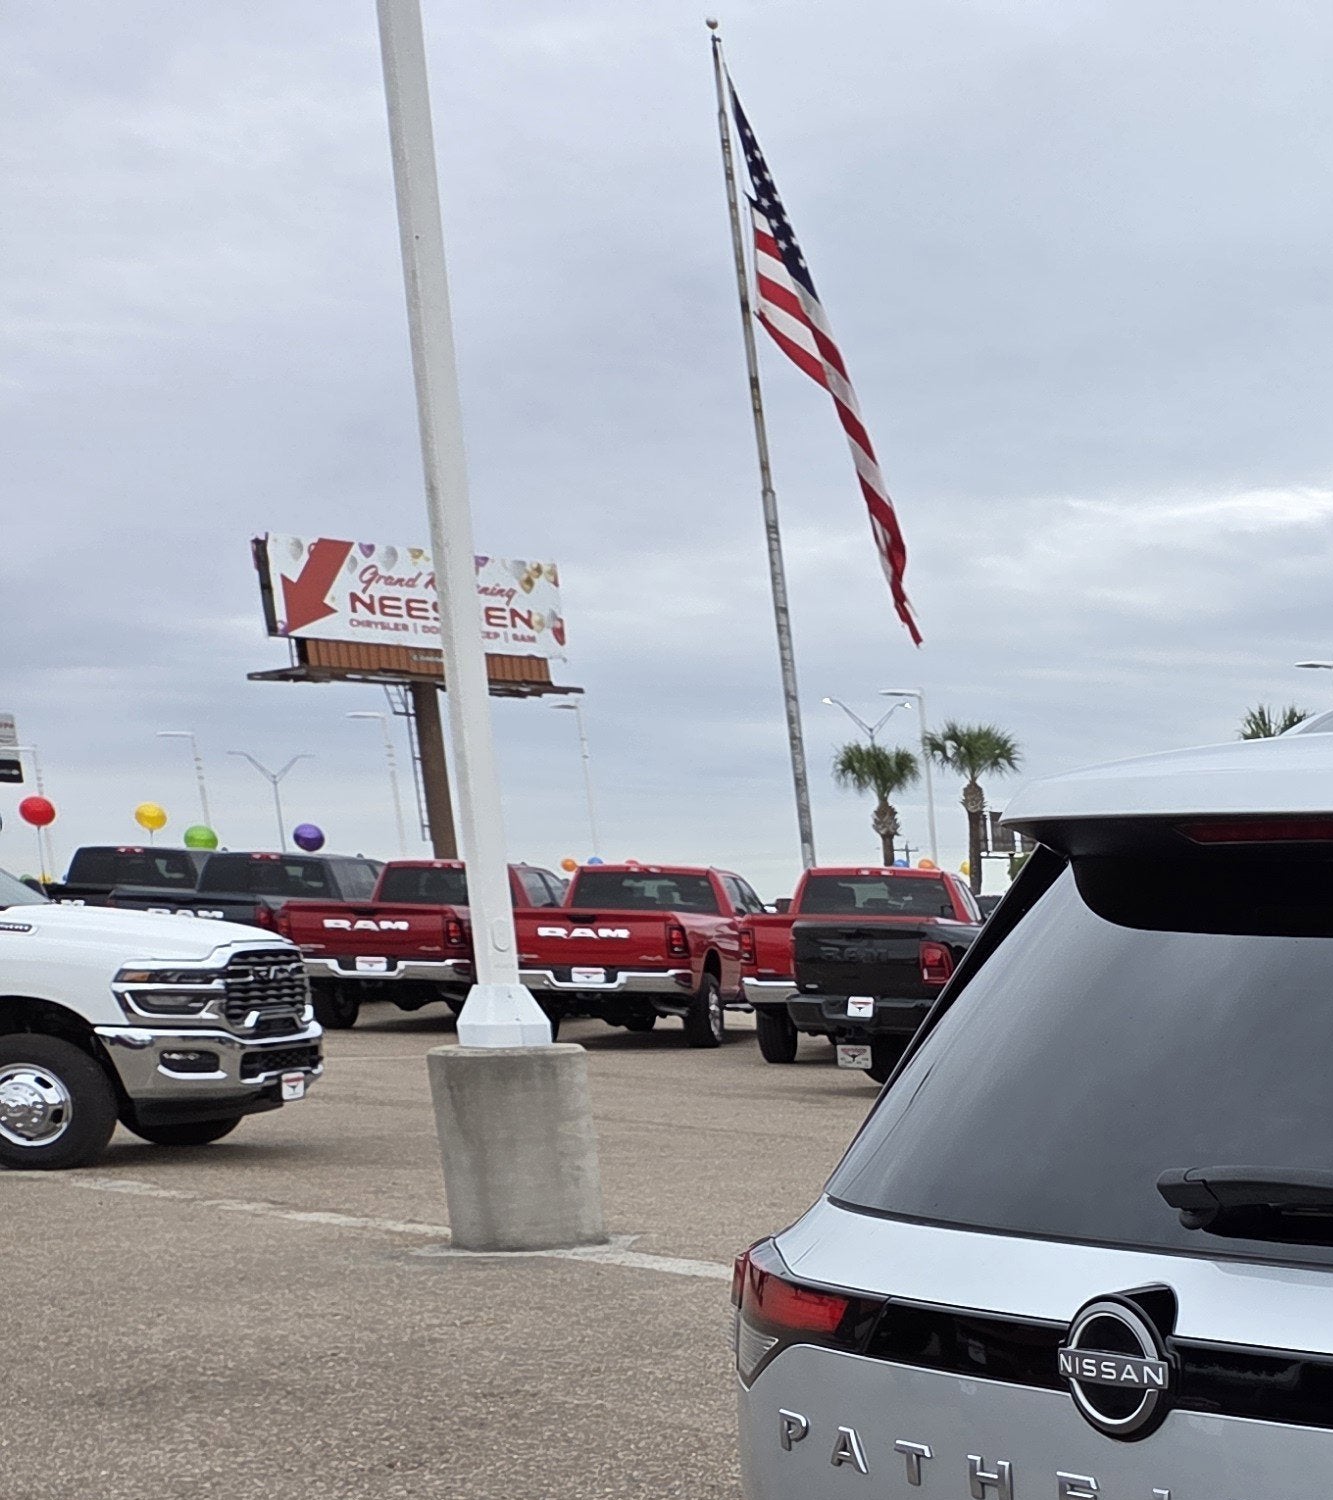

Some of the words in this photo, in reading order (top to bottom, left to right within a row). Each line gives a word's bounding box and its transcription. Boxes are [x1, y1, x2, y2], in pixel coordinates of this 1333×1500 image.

[359, 564, 423, 594] Grand
[349, 591, 535, 630] NEEEN
[323, 918, 410, 931] RAM
[537, 926, 631, 939] RAM
[1059, 1353, 1165, 1386] NISSAN
